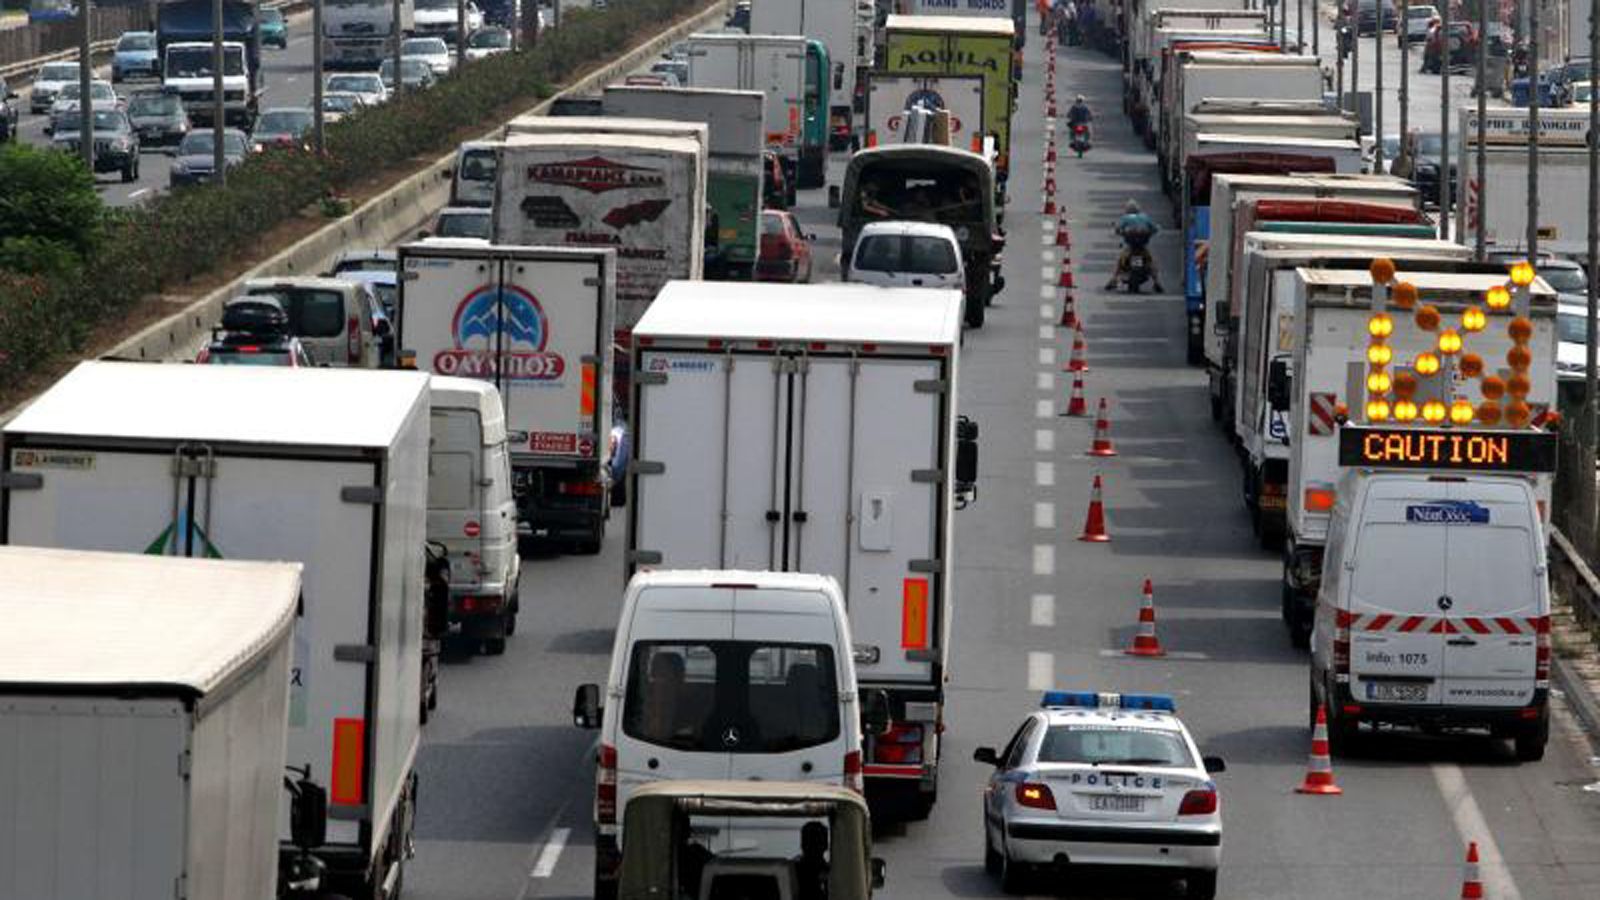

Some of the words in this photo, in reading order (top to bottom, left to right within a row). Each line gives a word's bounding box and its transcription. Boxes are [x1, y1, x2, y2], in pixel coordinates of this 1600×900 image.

[900, 50, 998, 71] AQUILA
[435, 352, 558, 376] ΟΛΥΜΠΟΣ
[1364, 433, 1508, 464] CAUTION
[1399, 653, 1428, 665] 1075
[1071, 773, 1163, 789] POLICE
